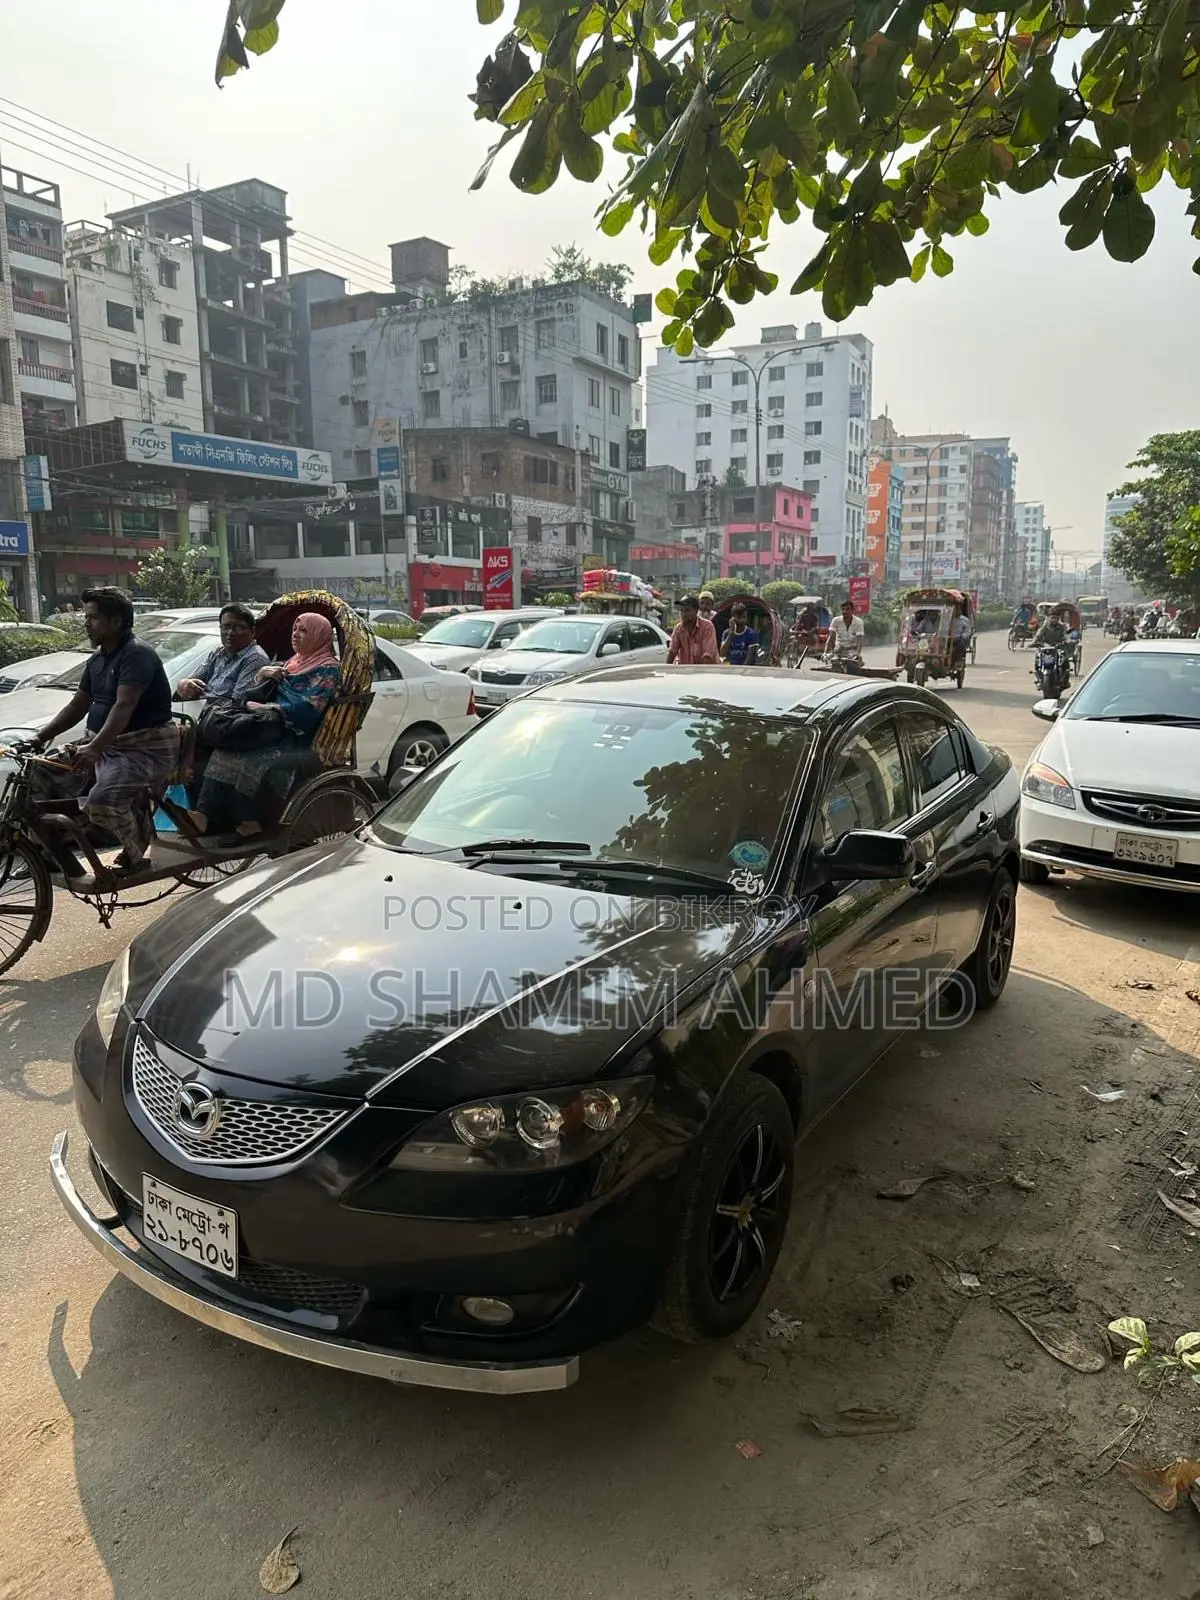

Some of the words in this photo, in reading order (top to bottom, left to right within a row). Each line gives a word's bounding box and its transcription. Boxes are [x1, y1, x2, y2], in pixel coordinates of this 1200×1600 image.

[132, 436, 167, 450] FUCHS
[302, 462, 328, 474] FUCHS
[609, 474, 631, 494] GYM
[487, 555, 509, 568] AKS
[146, 1190, 172, 1216] ঢাকা
[145, 1213, 234, 1272] ২১-৮৭০৬
